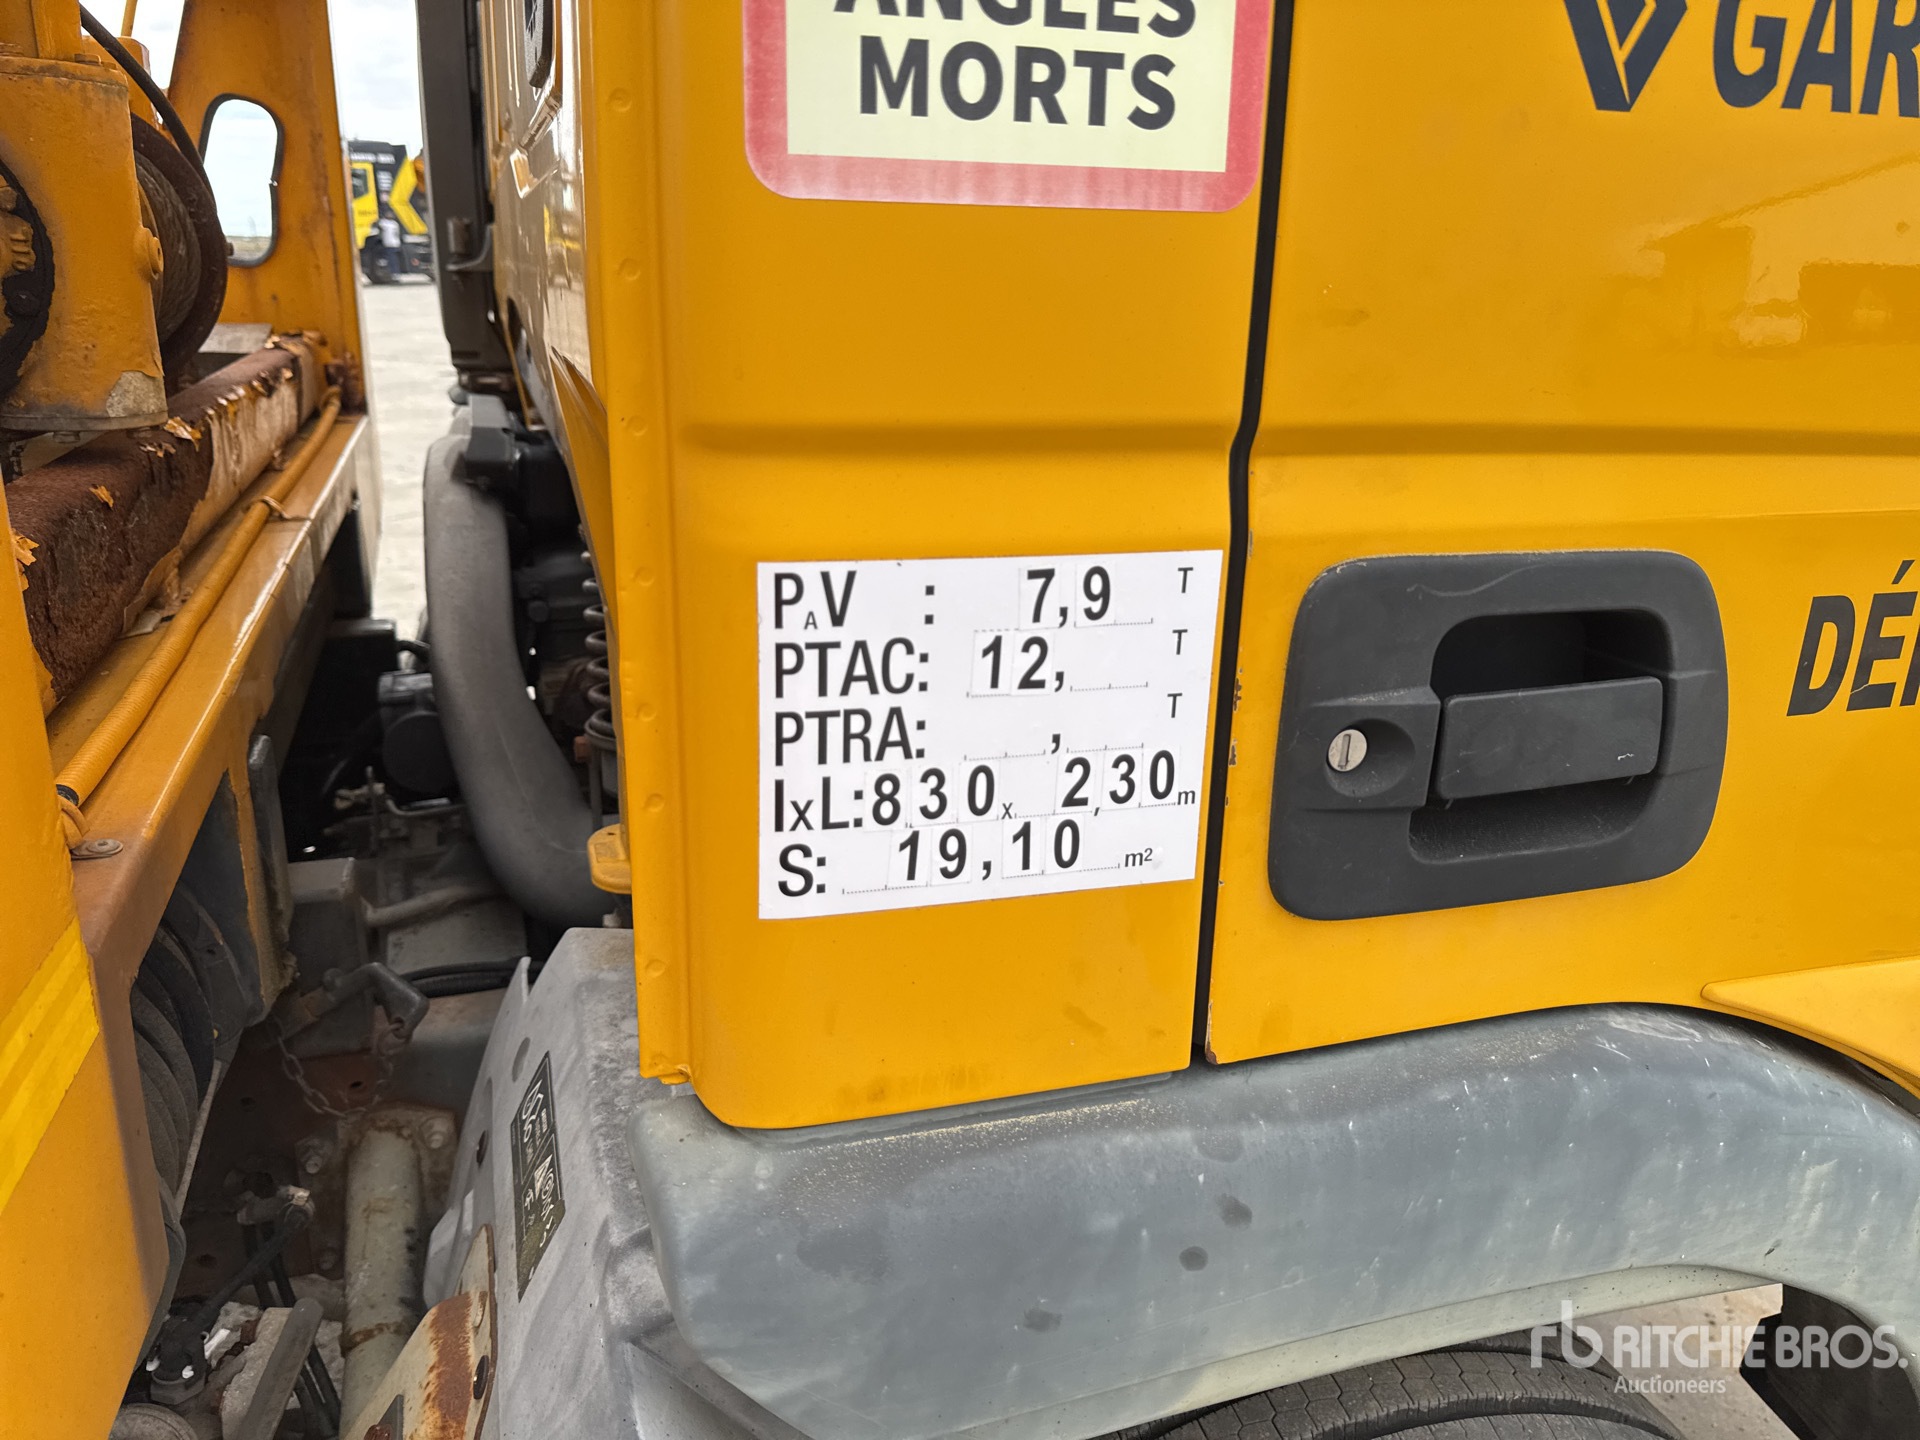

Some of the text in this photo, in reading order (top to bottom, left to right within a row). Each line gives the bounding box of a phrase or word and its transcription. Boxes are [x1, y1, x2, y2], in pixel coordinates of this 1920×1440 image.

[860, 35, 1177, 130] MORTS
[1027, 566, 1111, 627] 7,9
[1178, 567, 1194, 594] T
[774, 637, 929, 699] PTAC:
[1172, 629, 1188, 655] T
[1786, 559, 1920, 717] DÉ
[774, 706, 926, 767] PTRA:
[1167, 692, 1183, 718] T
[777, 843, 827, 898] S:
[899, 819, 1080, 882] 19,10
